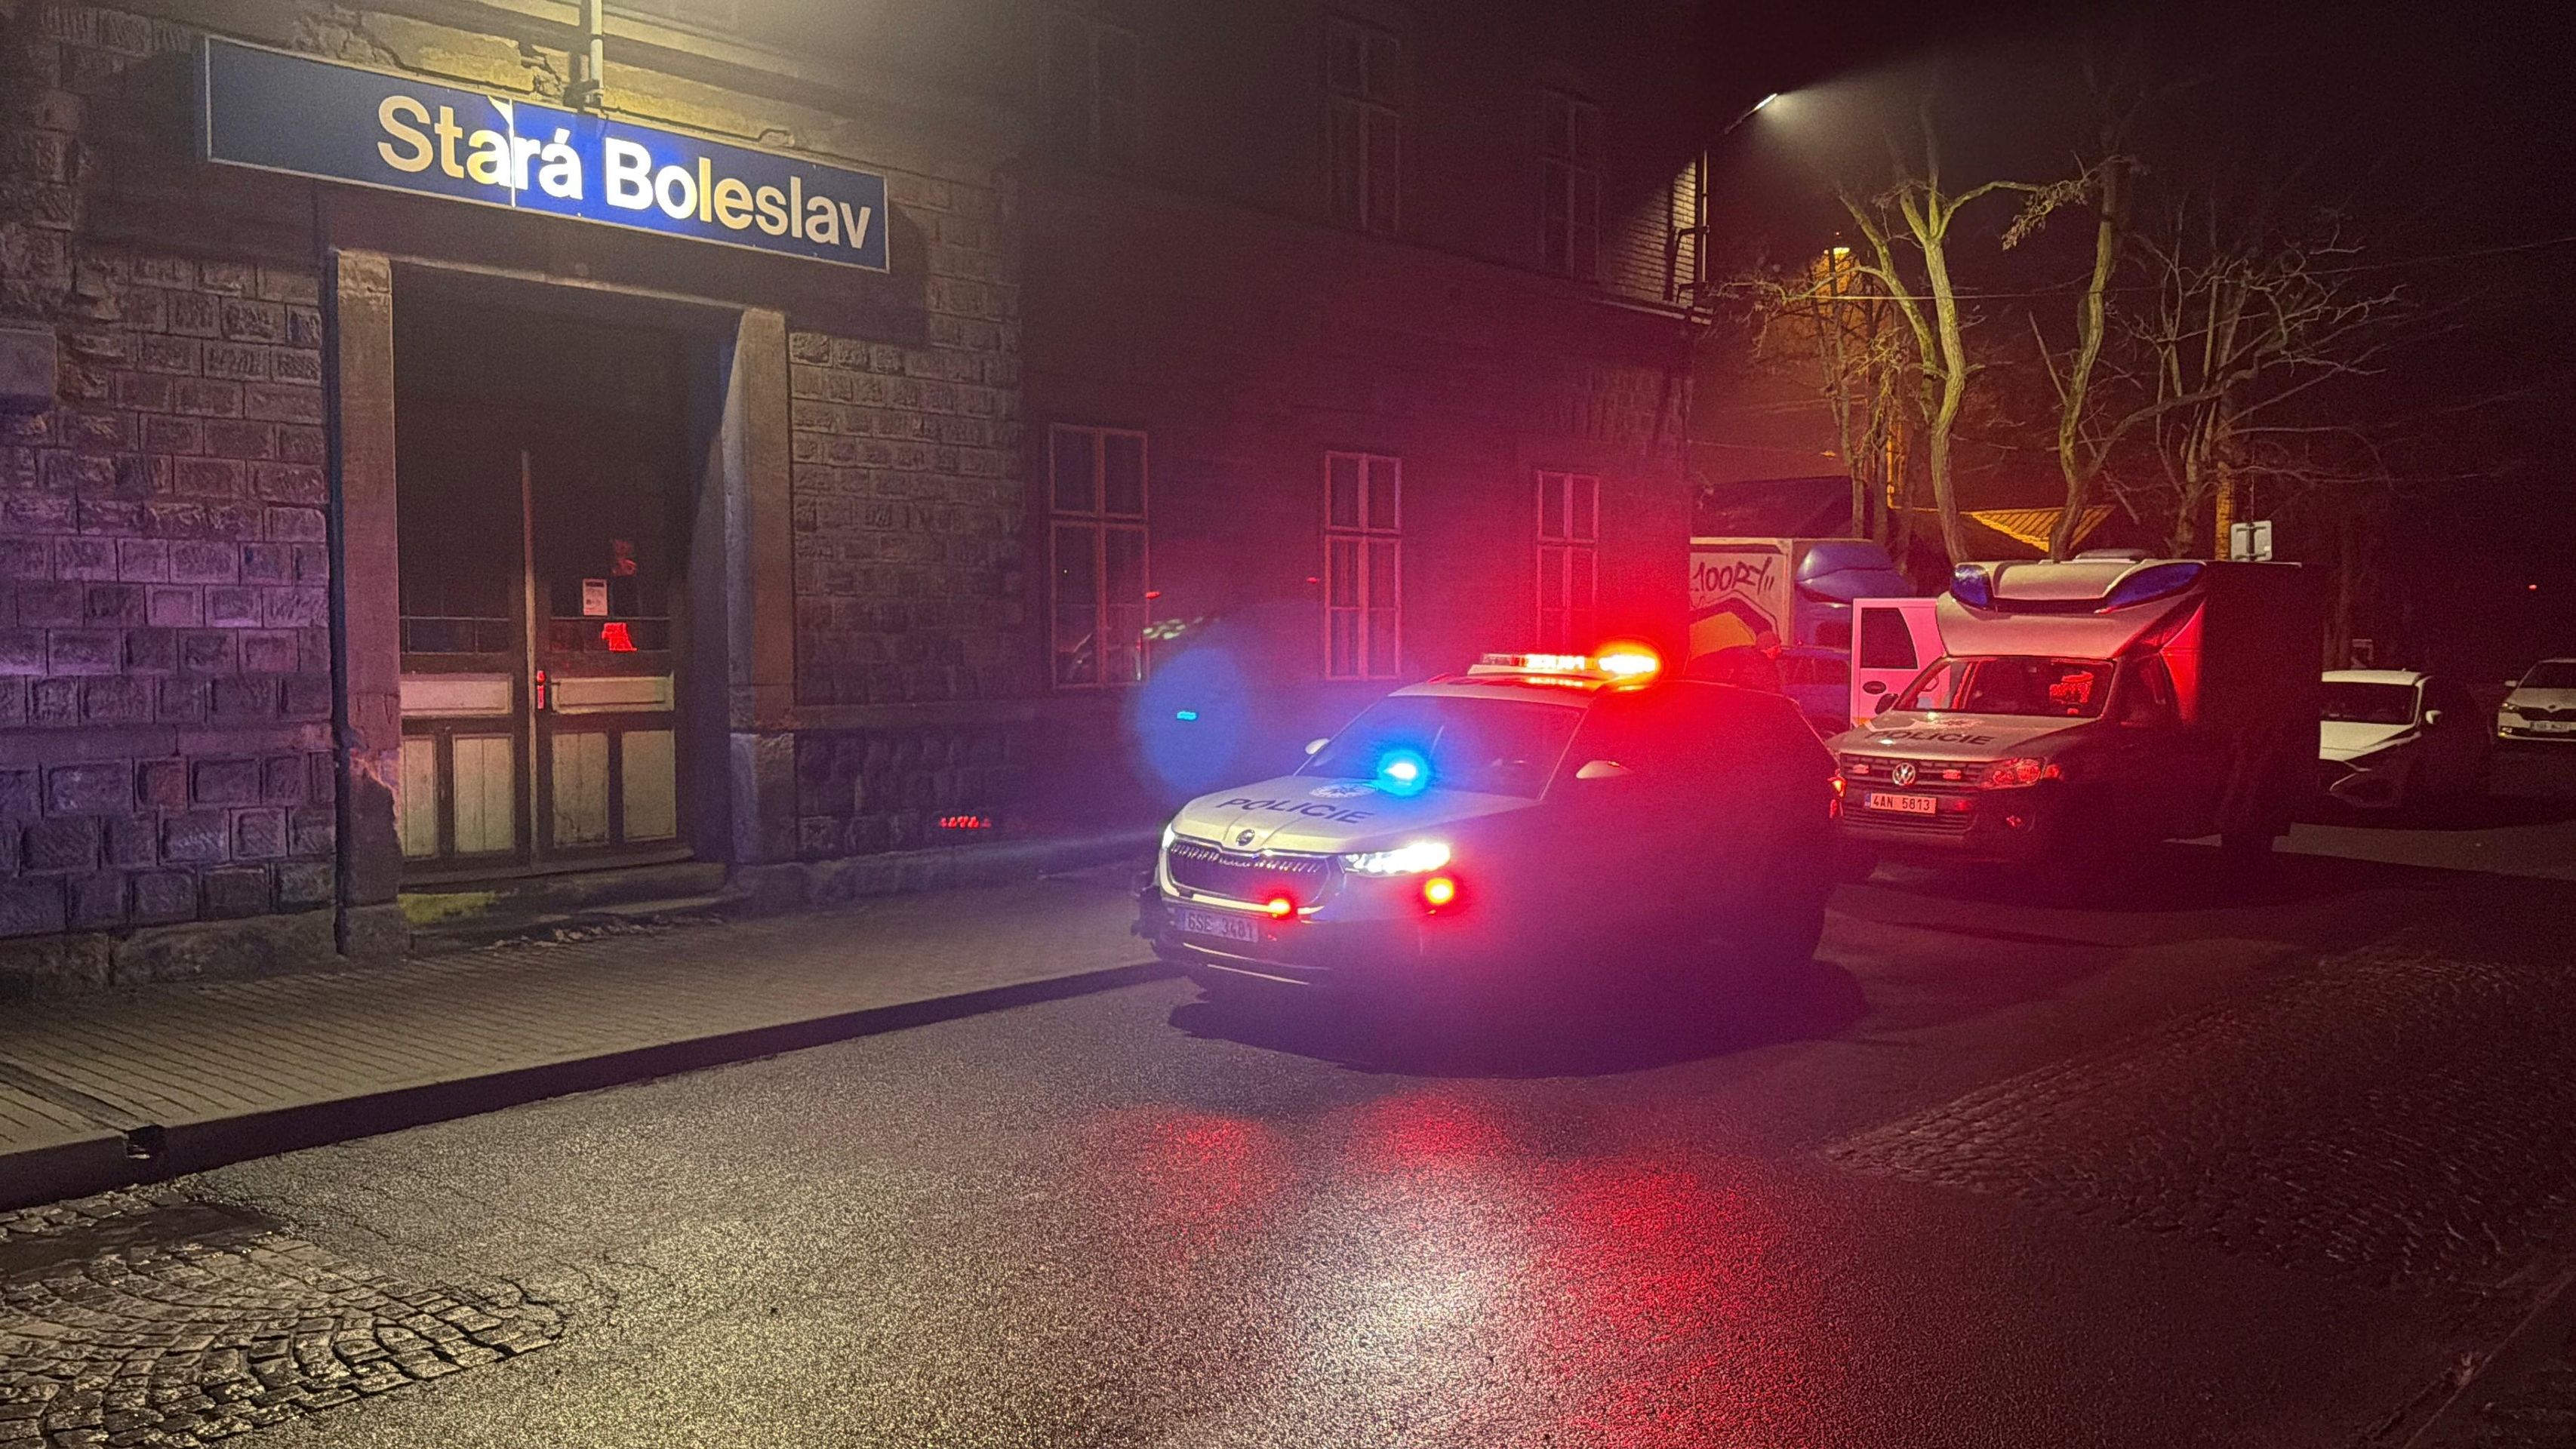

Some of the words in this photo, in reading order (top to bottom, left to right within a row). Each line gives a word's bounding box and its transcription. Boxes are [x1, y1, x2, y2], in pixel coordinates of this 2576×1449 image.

[377, 95, 583, 200] Stará
[605, 137, 872, 249] Boleslav
[1864, 731, 1995, 746] POLICIE
[1216, 798, 1376, 824] POLICIE
[1873, 795, 1894, 808] 4AN
[1902, 797, 1931, 811] 5813
[1188, 912, 1211, 932] 6SE
